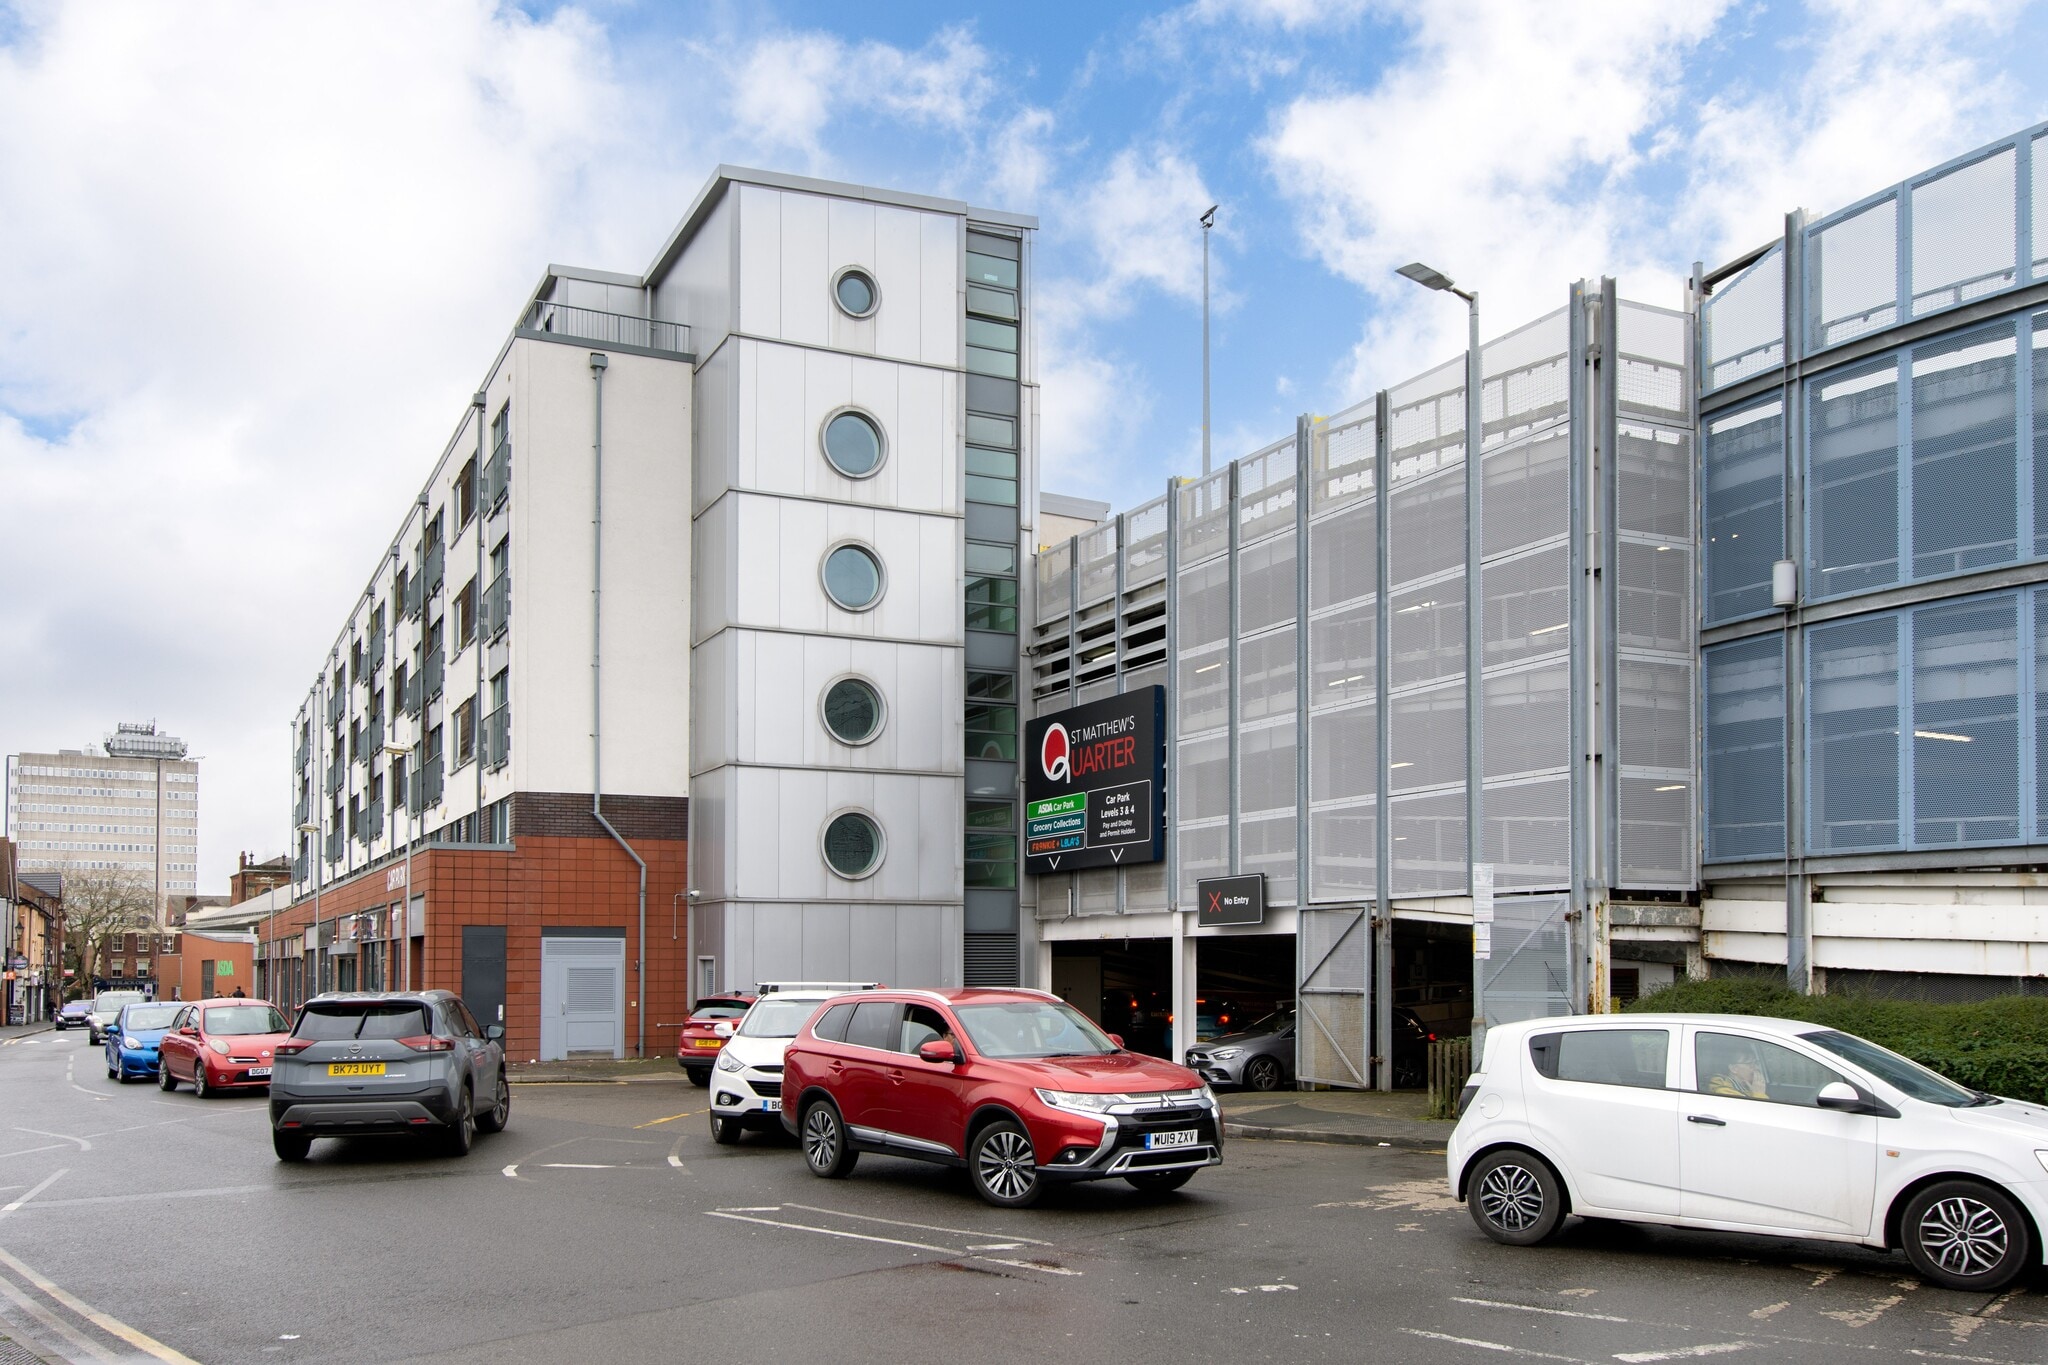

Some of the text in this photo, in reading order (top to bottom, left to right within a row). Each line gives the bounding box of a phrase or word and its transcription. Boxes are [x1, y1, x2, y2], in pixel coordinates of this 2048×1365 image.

[1071, 715, 1135, 744] ST MATTHEW'S
[1105, 792, 1130, 805] Car Park
[1037, 800, 1075, 815] ASDA Car Park
[1101, 805, 1135, 819] Levels 3 & 4
[1033, 817, 1081, 833] Grocery Collections
[1118, 819, 1133, 827] Display
[1099, 830, 1107, 838] and
[1107, 829, 1120, 837] Permit
[1224, 896, 1249, 905] No Entry
[216, 960, 234, 976] ASDA
[333, 1064, 381, 1075] BK73 UYT
[1154, 1131, 1194, 1145] WU19 ZXV
